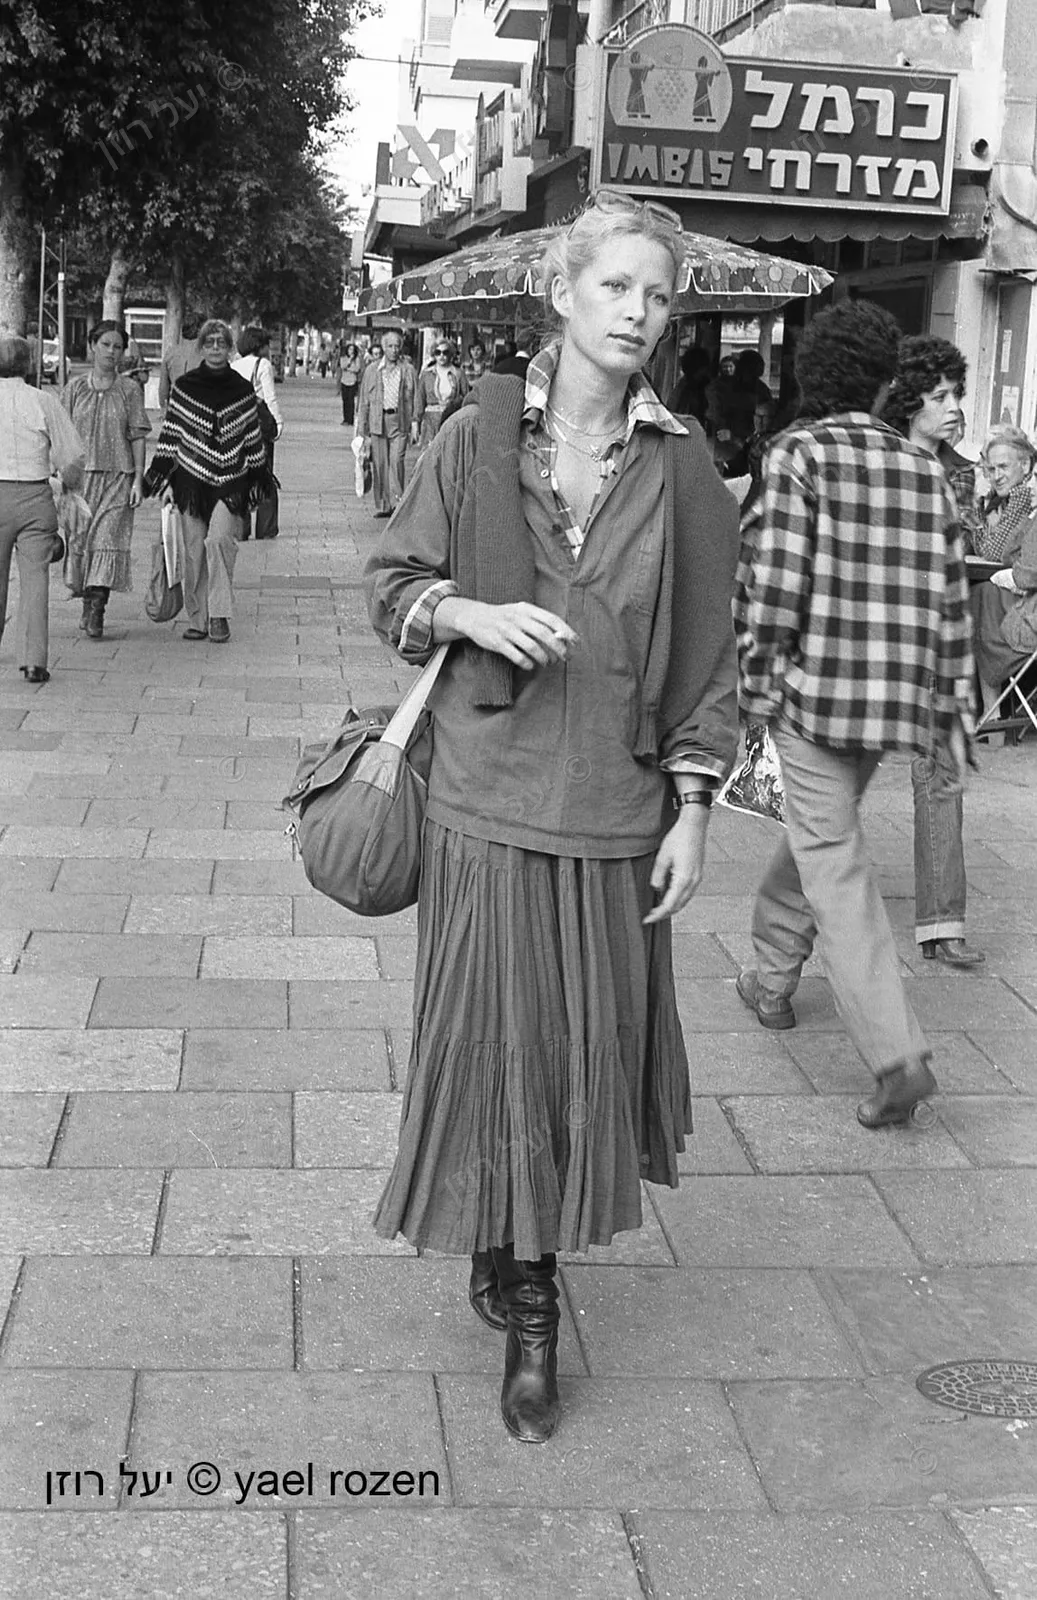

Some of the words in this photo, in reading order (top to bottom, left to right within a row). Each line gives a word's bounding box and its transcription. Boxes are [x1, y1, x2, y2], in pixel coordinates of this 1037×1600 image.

[745, 70, 944, 140] כרמל
[607, 142, 734, 186] IMBIS
[743, 147, 940, 199] מזרחי
